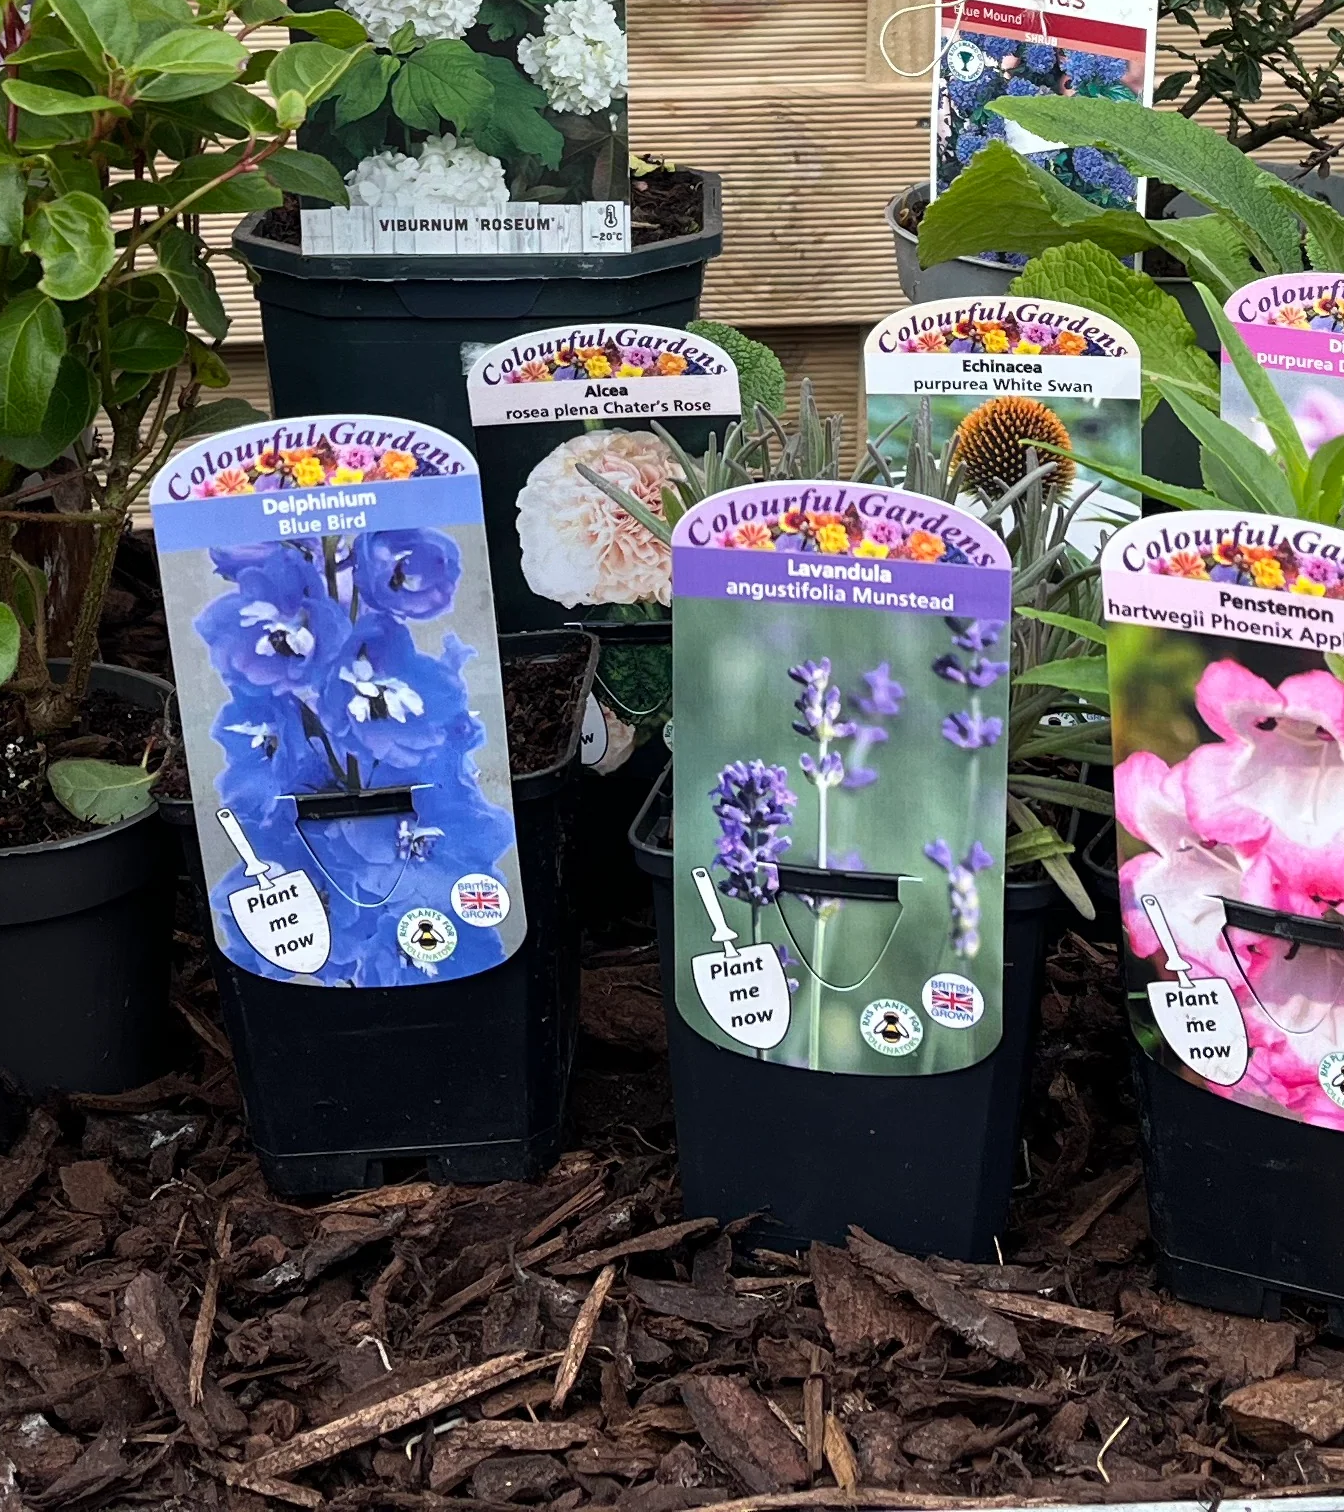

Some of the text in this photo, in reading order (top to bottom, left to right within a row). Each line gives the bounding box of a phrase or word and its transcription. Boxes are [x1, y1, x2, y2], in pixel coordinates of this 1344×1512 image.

[983, 7, 1023, 26] Mound
[1024, 32, 1058, 46] SHRUB
[379, 217, 556, 232] VIBURNUM 'ROSEUM'
[878, 301, 1129, 358] Colourful Gardens
[482, 328, 728, 386] Colourful Gardens
[962, 359, 1043, 374] Echinacea
[1256, 351, 1334, 372] purpurea
[584, 384, 629, 398] Alcea
[913, 377, 1093, 394] purpurea White Swan
[506, 399, 711, 420] rosea plena Chater's Rose
[168, 422, 465, 501] Colourful Gardens
[262, 489, 377, 516] Delphinium
[279, 511, 367, 536] Blue Bird
[687, 488, 996, 568] Colourful Gardens
[1122, 520, 1278, 573] Colourful
[787, 558, 893, 584] Lavandula
[726, 580, 954, 612] angustifolia Munstead
[1219, 591, 1335, 624] Penstemon
[1108, 598, 1205, 629] hartwegii
[1211, 613, 1293, 641] Phoenix
[246, 883, 299, 914] Plant
[269, 912, 299, 933] me
[399, 910, 455, 937] RHS PLANTS FOR
[461, 910, 502, 919] GROWN
[274, 933, 315, 958] now
[403, 940, 455, 961] POLLINATORS
[710, 957, 764, 980] Plant
[729, 985, 760, 1002] me
[931, 980, 974, 994] BRITISH
[1165, 990, 1219, 1008] Plant
[731, 1009, 774, 1028] now
[862, 1001, 921, 1034] RHS PLANTS FOR
[931, 1009, 975, 1023] GROWN
[1186, 1017, 1217, 1033] me
[865, 1031, 920, 1055] POLLINATORS
[1189, 1043, 1231, 1060] now
[1320, 1059, 1331, 1078] RHS
